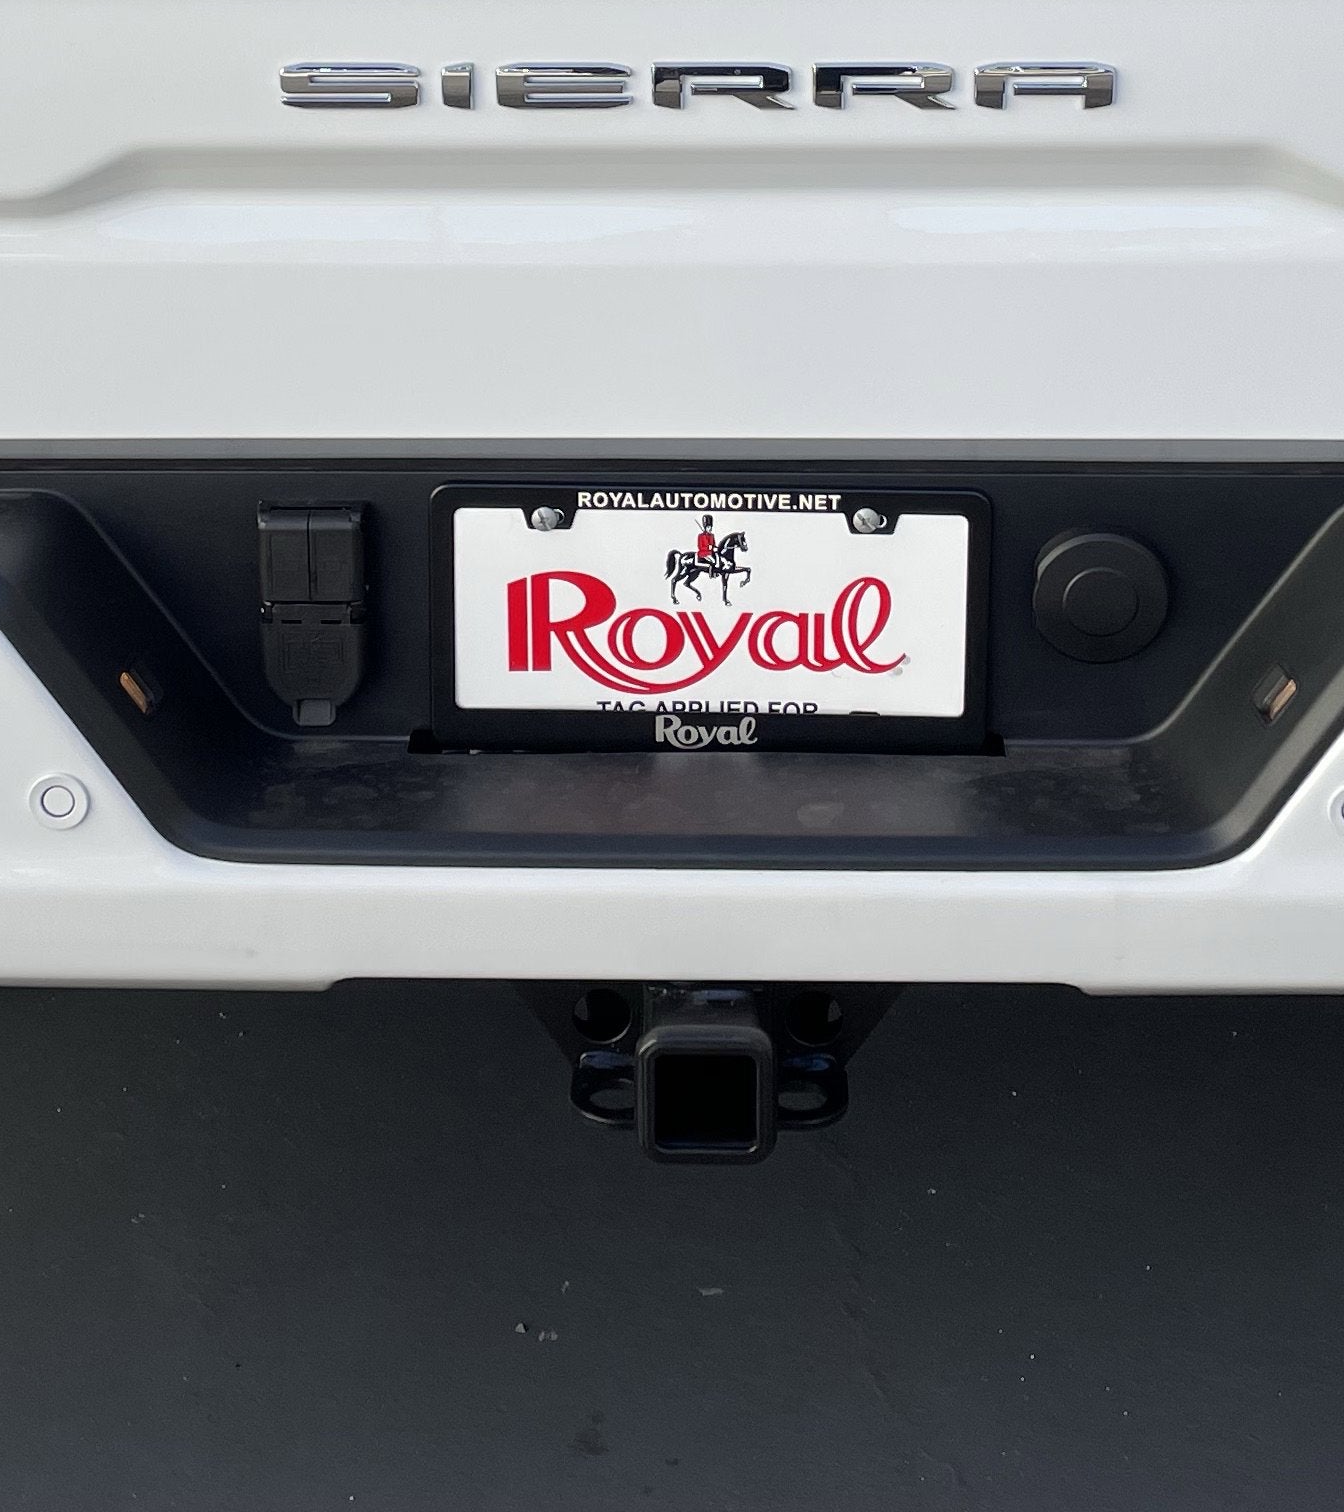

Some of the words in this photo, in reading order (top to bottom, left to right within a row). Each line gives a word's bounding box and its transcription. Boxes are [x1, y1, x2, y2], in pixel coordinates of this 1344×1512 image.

[278, 60, 1119, 112] SIERRA
[576, 491, 843, 511] ROYALAUTOMOTIVE.NET
[506, 570, 908, 695] Royal
[655, 713, 758, 750] Royal
